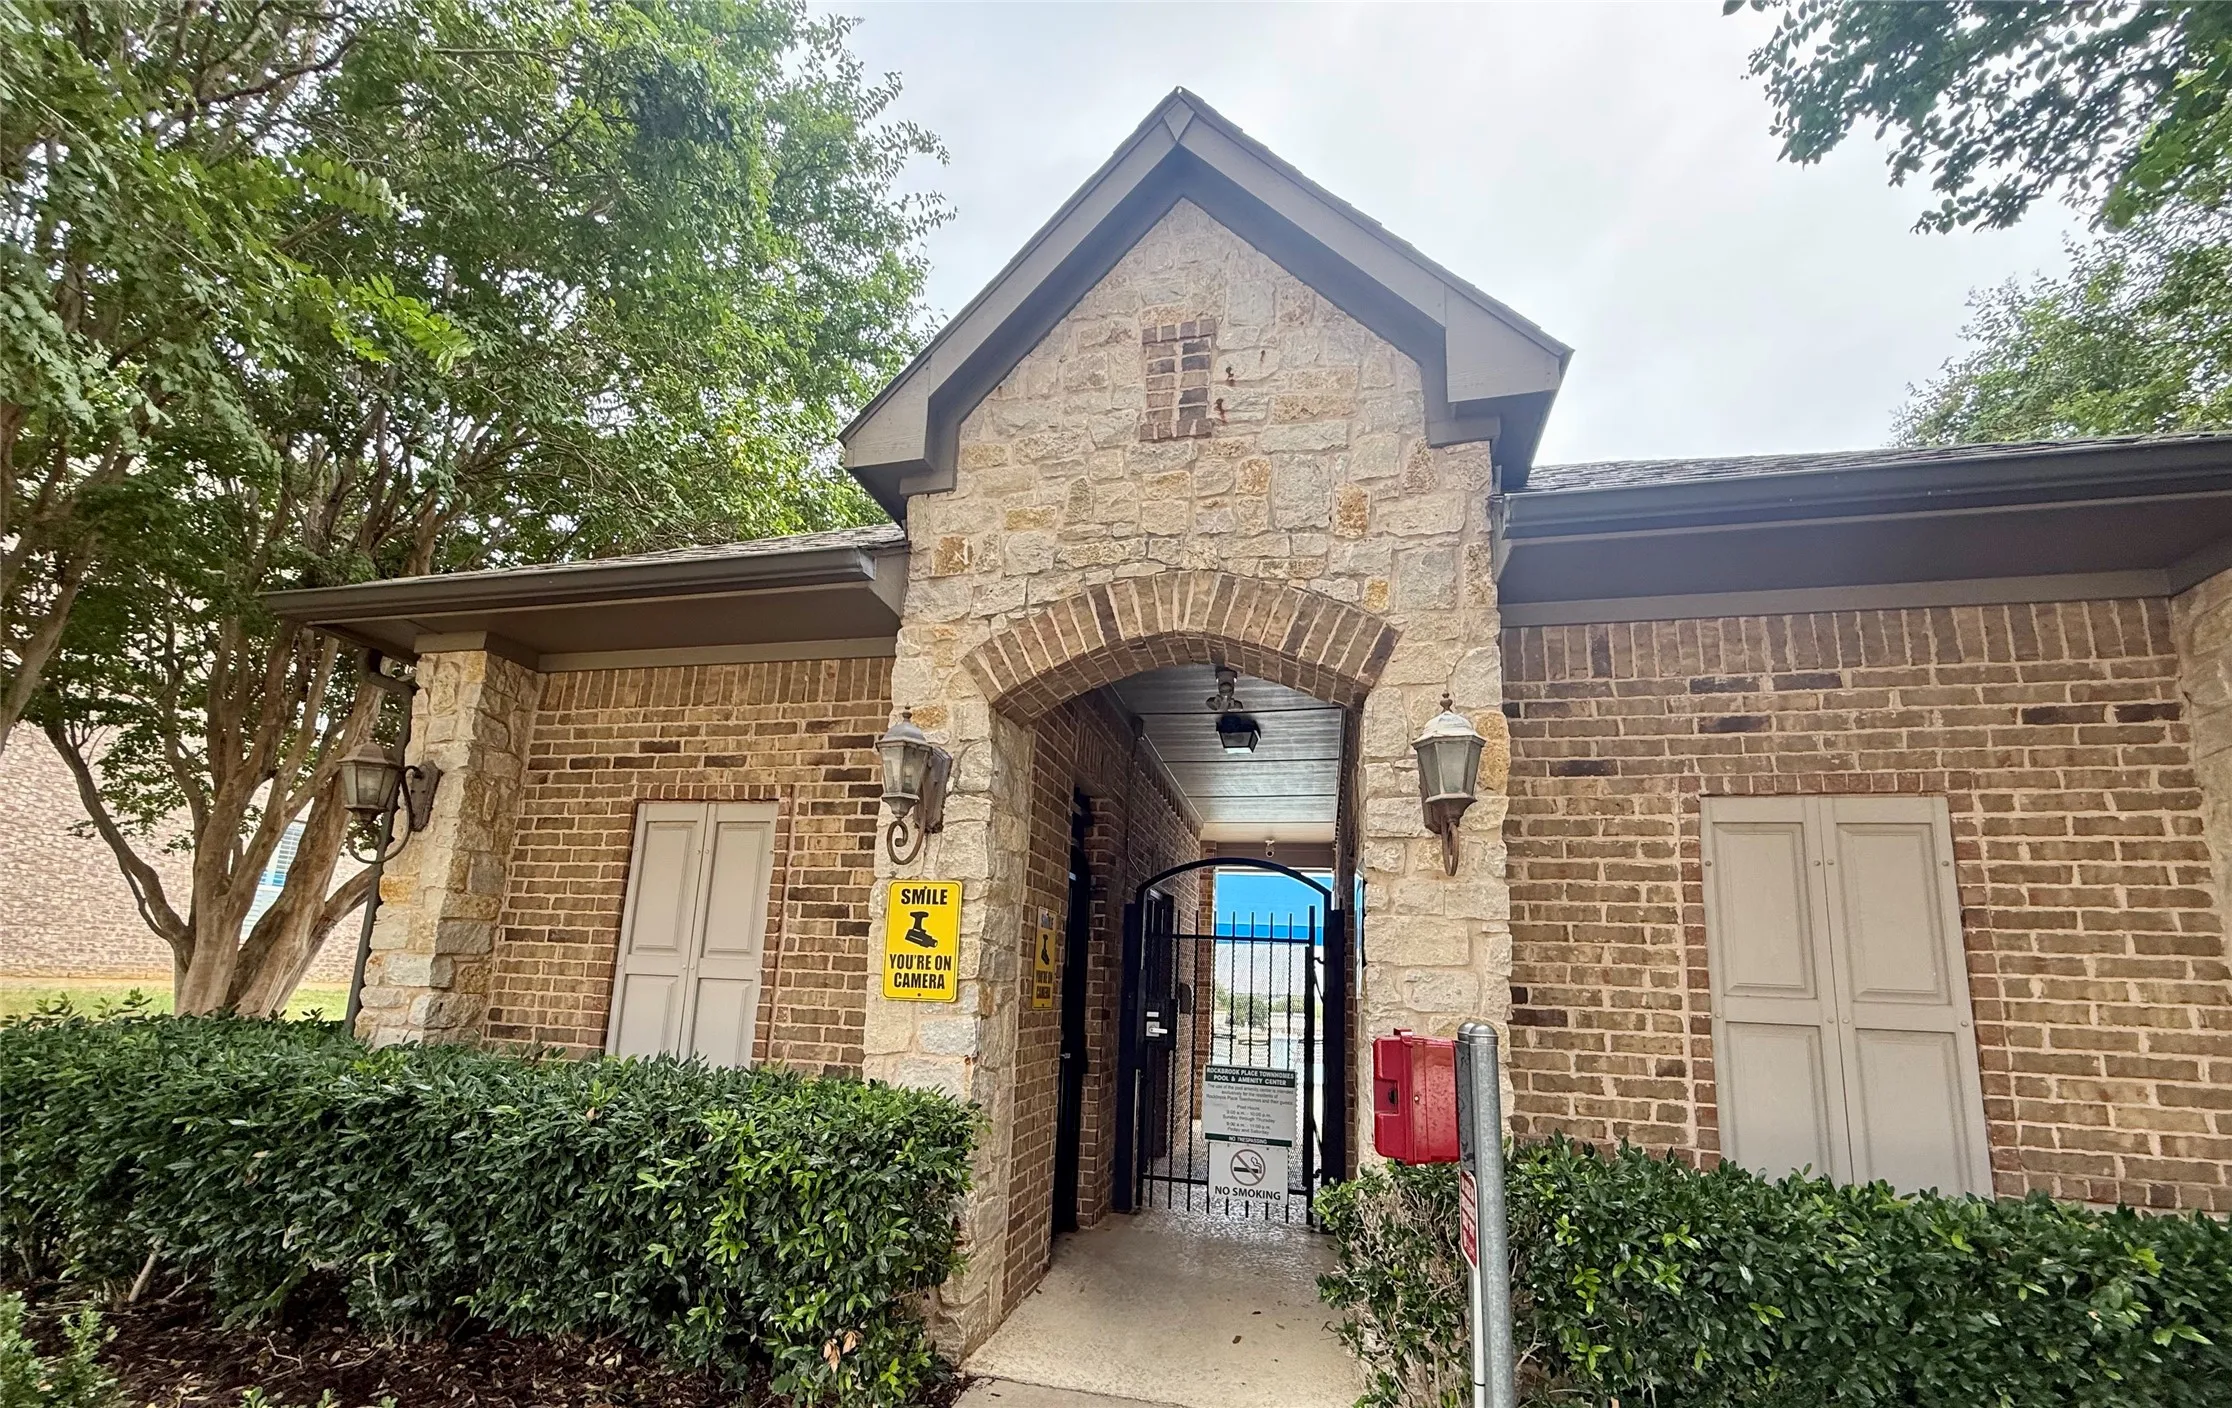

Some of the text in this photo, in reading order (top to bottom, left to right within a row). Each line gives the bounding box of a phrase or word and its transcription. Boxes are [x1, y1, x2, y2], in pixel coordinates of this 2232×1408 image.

[901, 888, 948, 905] SMILE
[890, 954, 952, 971] YOU'RE ON
[894, 972, 945, 989] CAMERA
[1207, 1066, 1240, 1075] ROCKBROOK
[1259, 1070, 1294, 1079] TOWNHOMES
[1215, 1186, 1281, 1200] NO SMOKING
